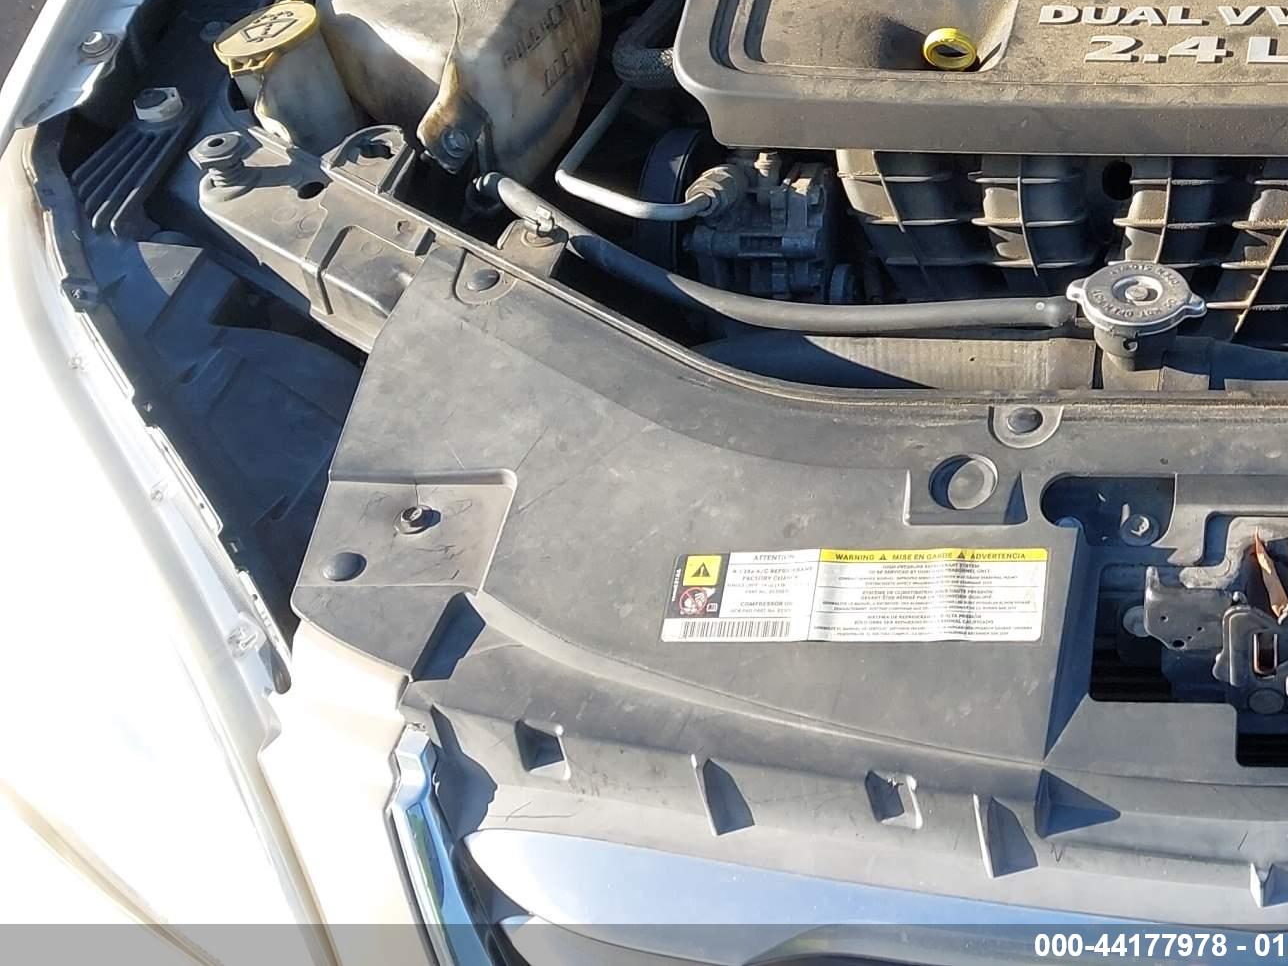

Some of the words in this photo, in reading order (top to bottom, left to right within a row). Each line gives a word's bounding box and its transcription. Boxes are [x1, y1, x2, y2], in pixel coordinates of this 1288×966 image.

[1038, 5, 1206, 26] DUAL
[835, 552, 875, 561] WARNING
[926, 552, 953, 560] GARDE
[970, 552, 1026, 560] ADVERTENCIA
